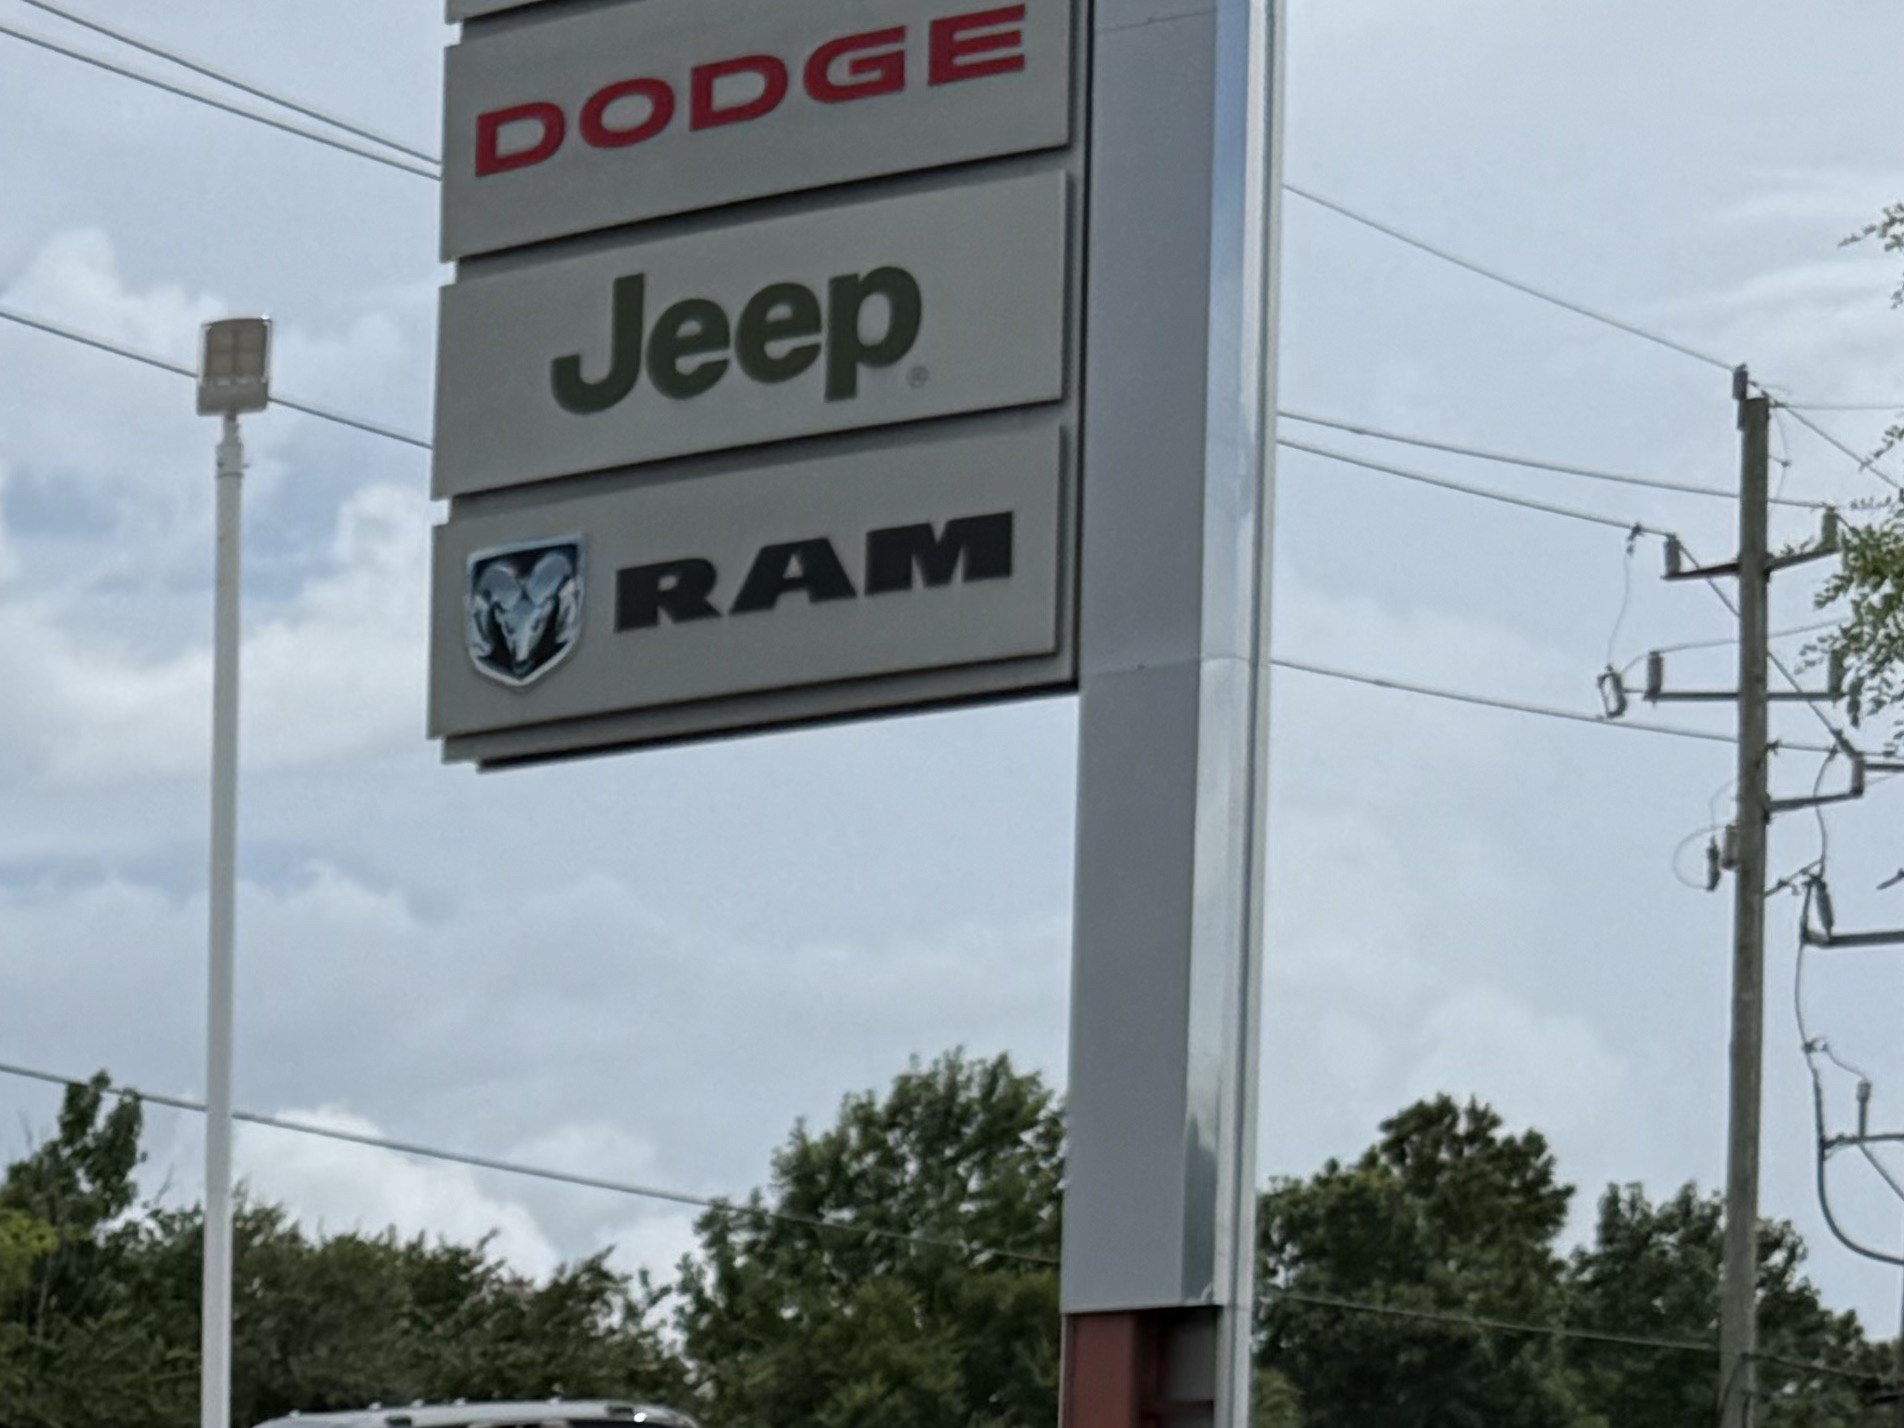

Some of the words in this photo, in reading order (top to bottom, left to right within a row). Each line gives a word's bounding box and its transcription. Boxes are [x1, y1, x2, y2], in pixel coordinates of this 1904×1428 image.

[475, 3, 1026, 177] DODGE
[550, 265, 923, 415] Jeep
[613, 511, 1014, 633] RAM
